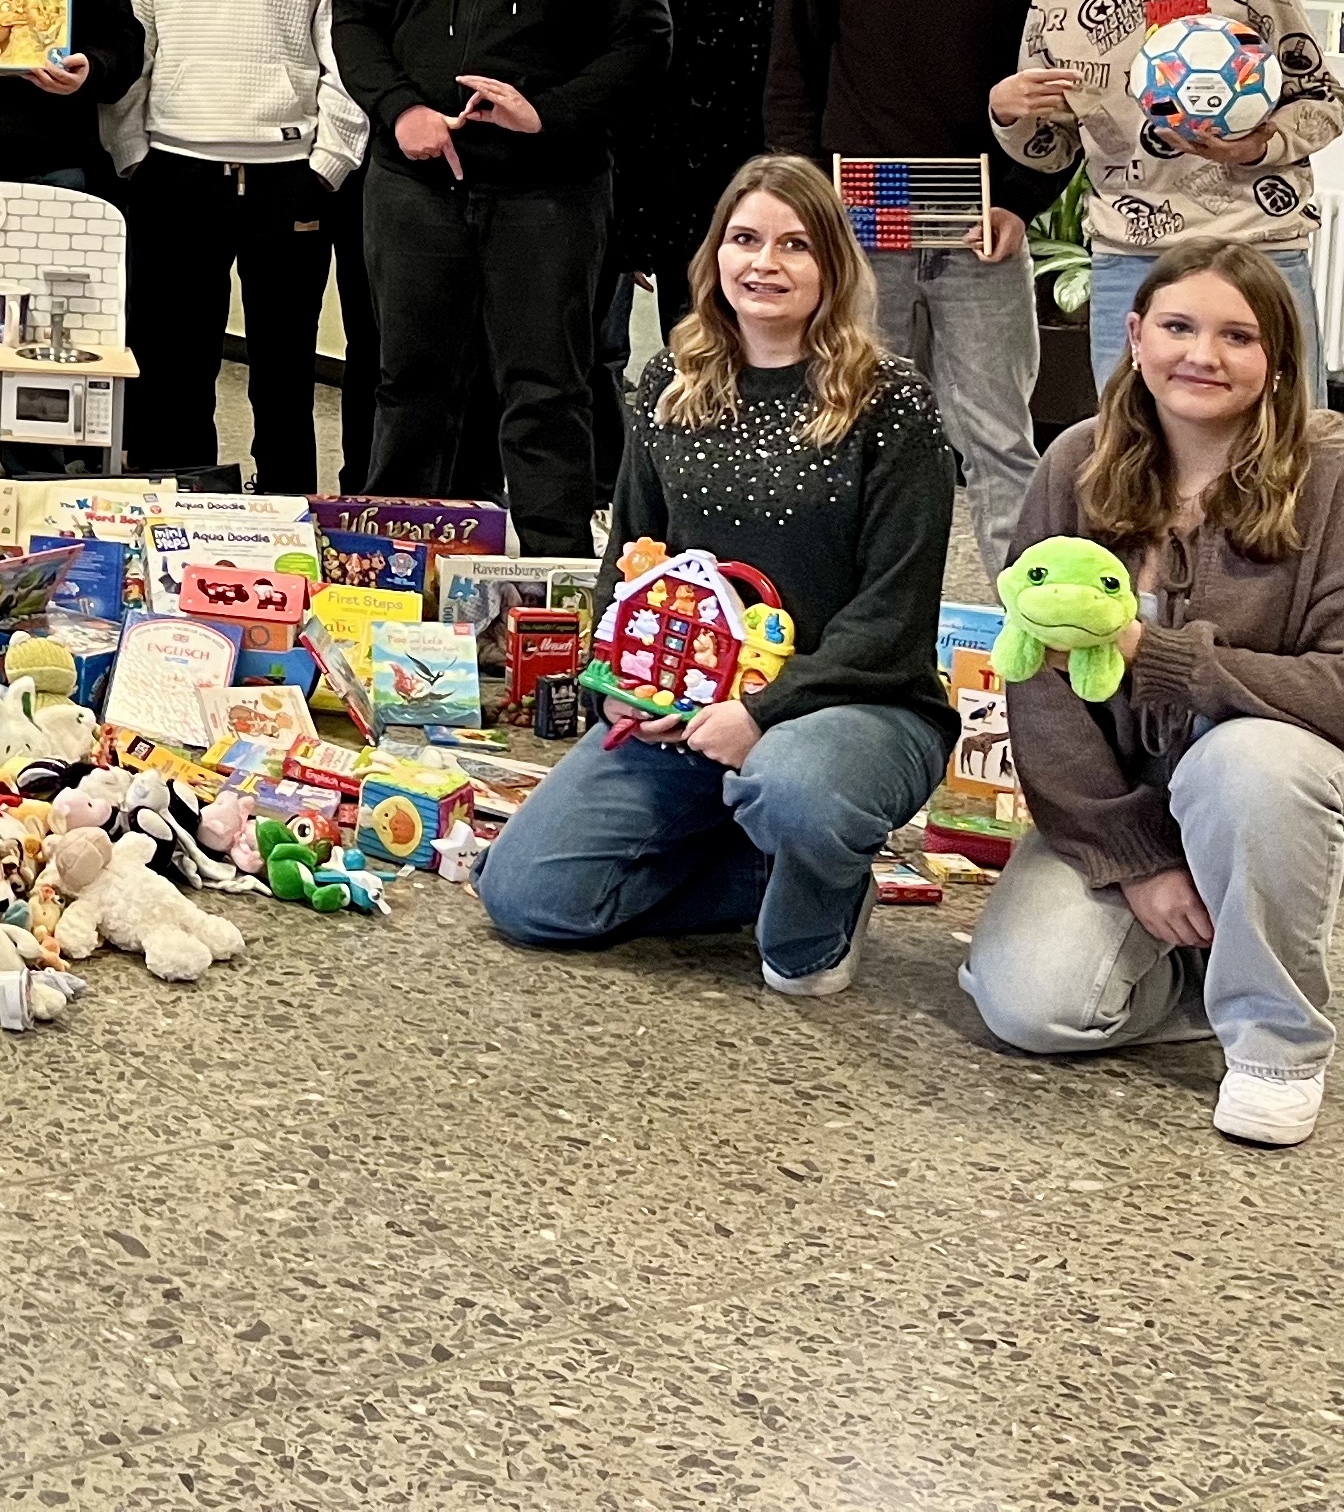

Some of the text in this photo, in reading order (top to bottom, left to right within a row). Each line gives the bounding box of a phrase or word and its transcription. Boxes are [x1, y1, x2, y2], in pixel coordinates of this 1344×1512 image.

[174, 500, 280, 514] Aqua Doodle XXL
[84, 511, 148, 525] Word Boo
[192, 531, 307, 547] Aqua Doodle XXL
[328, 591, 404, 611] First Steps
[324, 622, 356, 634] abc
[146, 641, 210, 661] ENGLISCH
